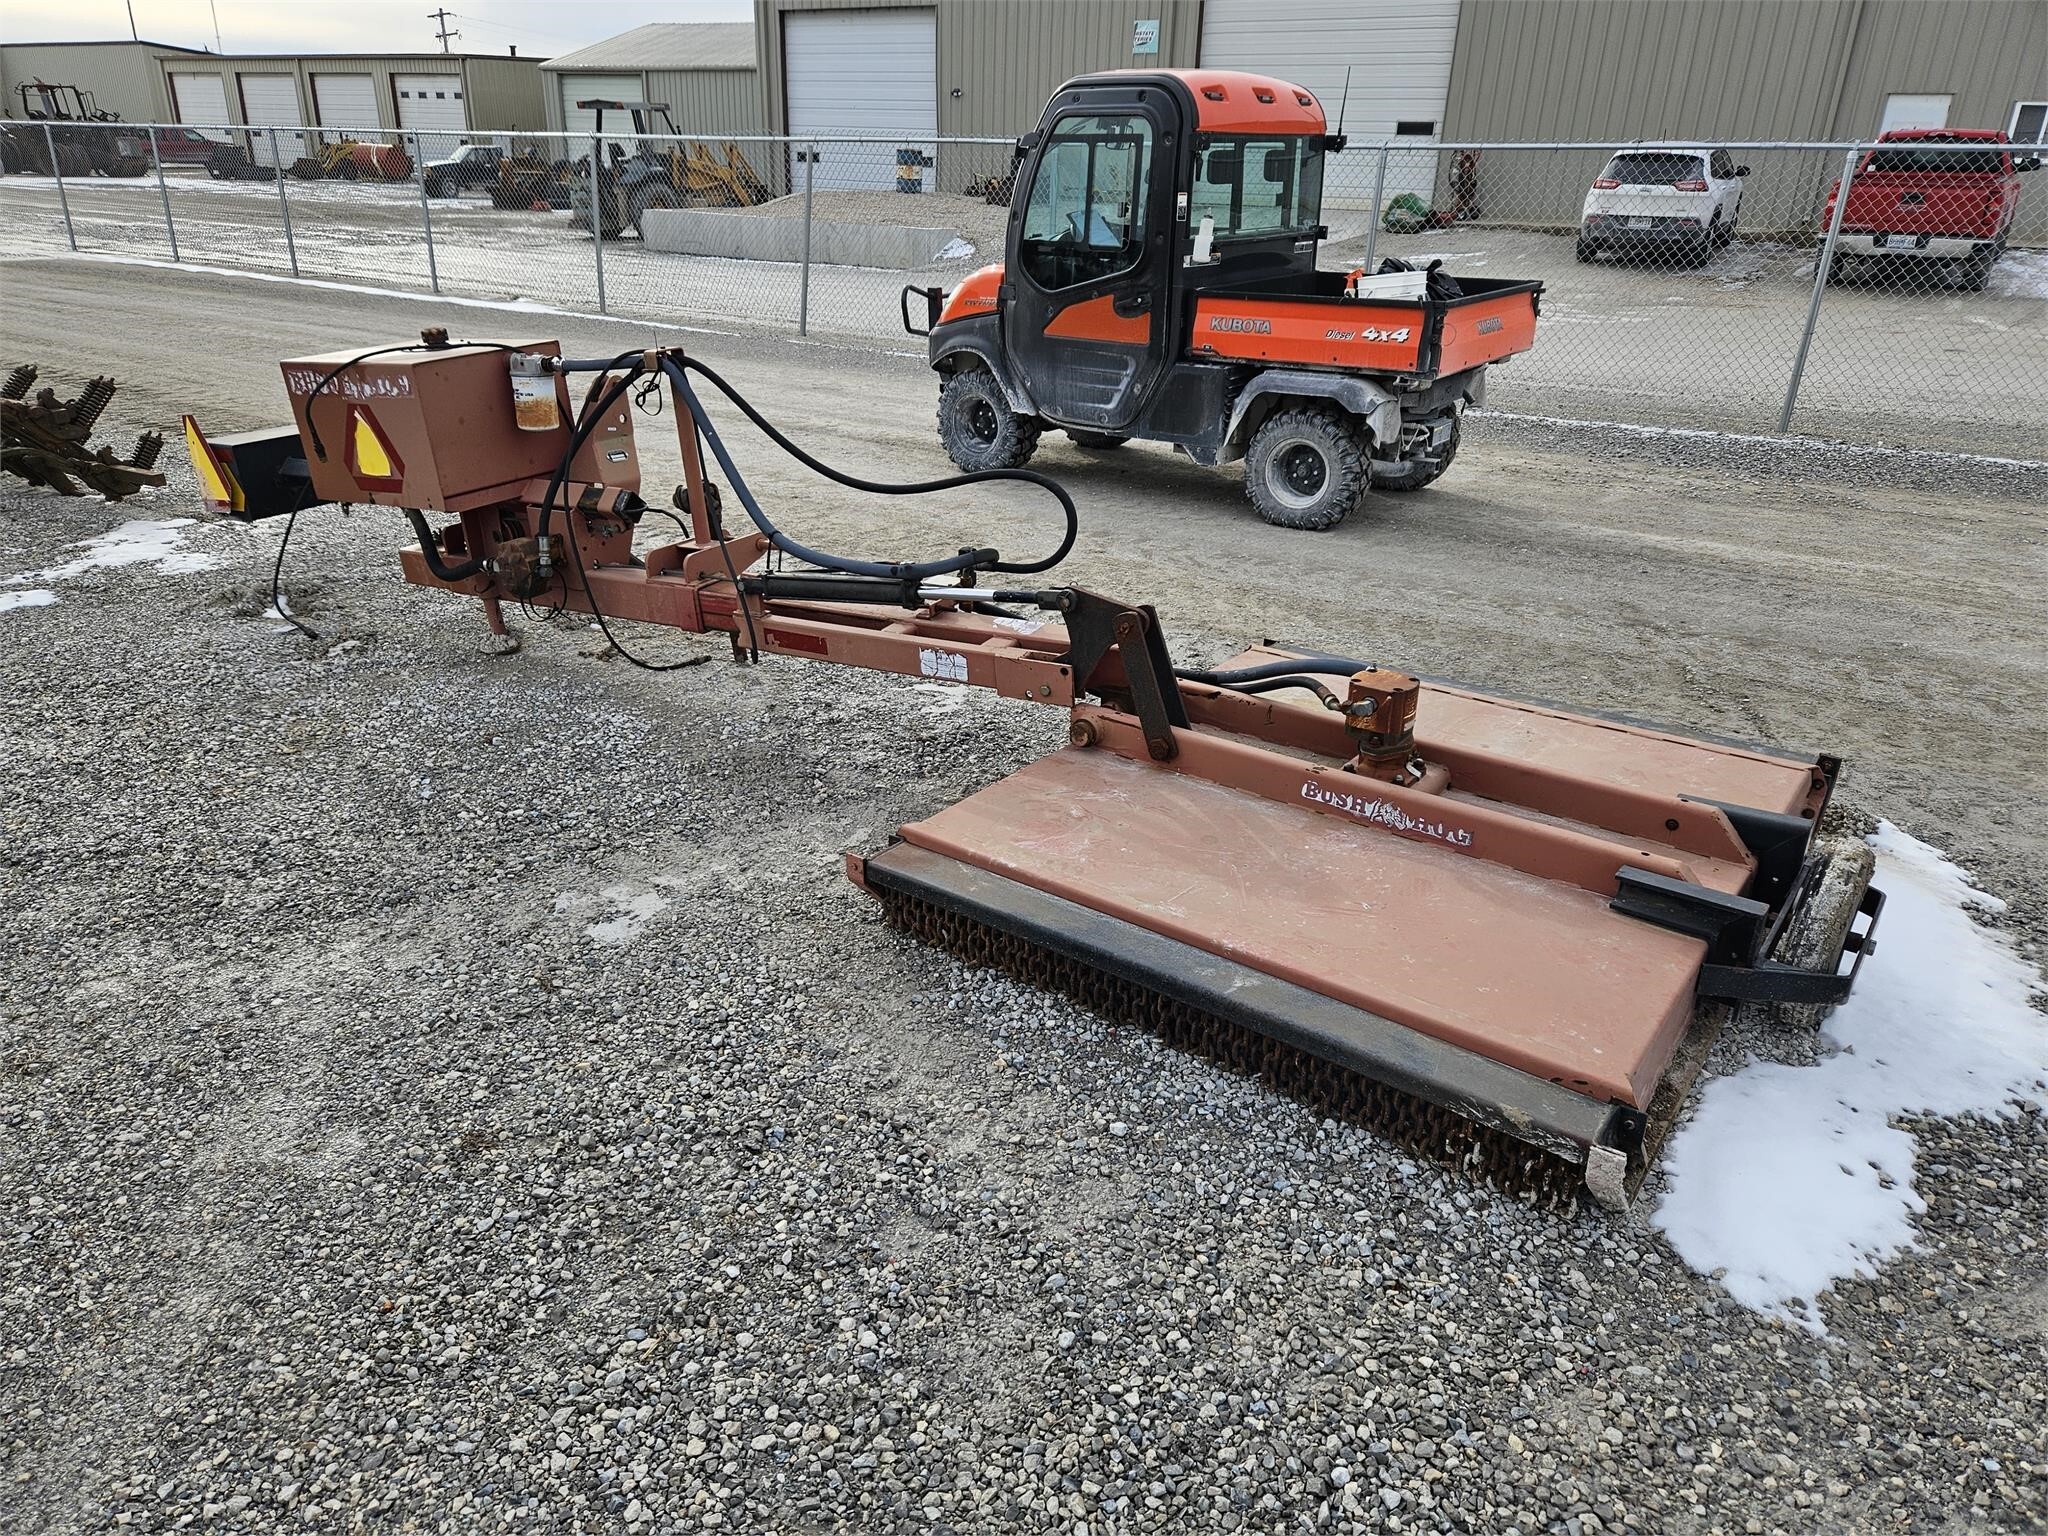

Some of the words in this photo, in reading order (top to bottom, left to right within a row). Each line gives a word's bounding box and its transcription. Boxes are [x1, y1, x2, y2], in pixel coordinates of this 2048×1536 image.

[1210, 316, 1271, 335] KUBOTA
[1325, 329, 1356, 341] Diesel
[1361, 326, 1410, 343] 4x4
[1304, 781, 1367, 814] BUSH
